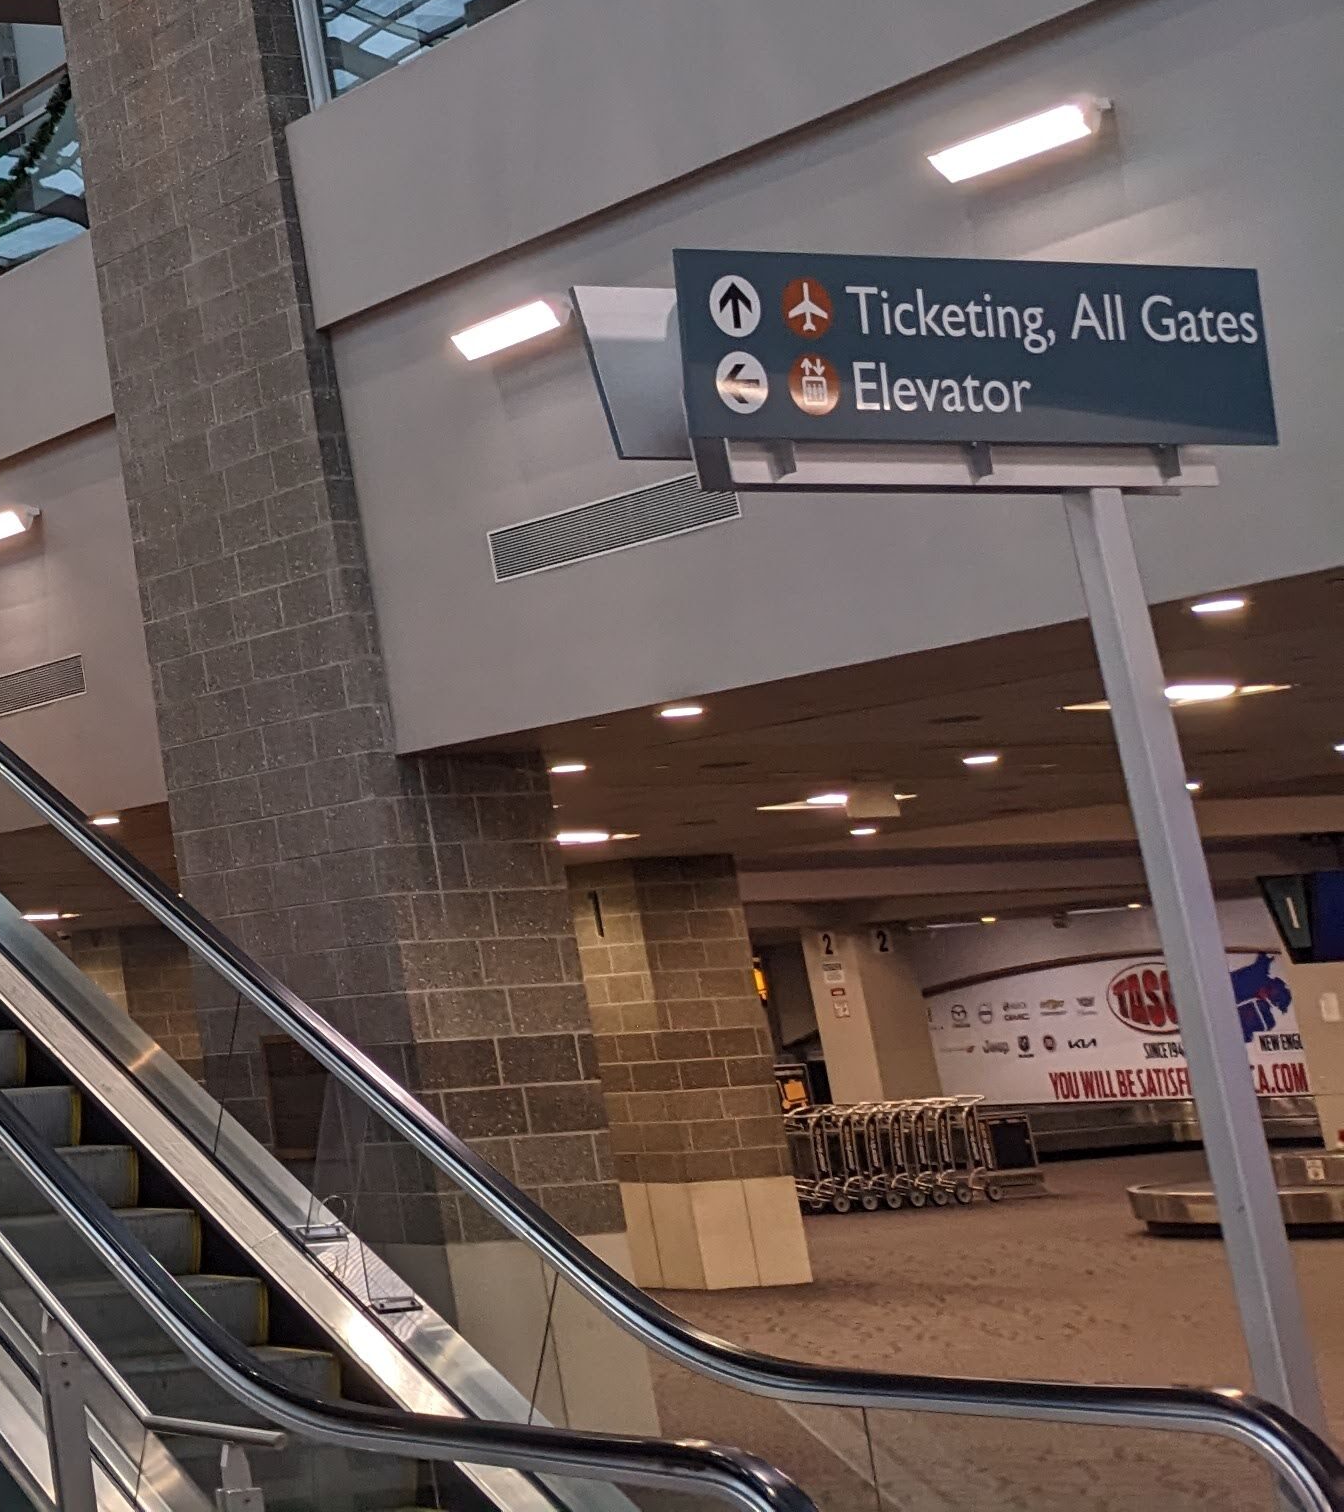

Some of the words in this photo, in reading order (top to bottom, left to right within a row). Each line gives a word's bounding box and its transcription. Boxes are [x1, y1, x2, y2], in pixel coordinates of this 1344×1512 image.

[845, 285, 1057, 354] Ticketing,
[1071, 292, 1127, 341] All
[1141, 294, 1259, 344] Gates
[852, 361, 1032, 414] Elevator
[822, 933, 834, 955] 2
[876, 929, 889, 953] 2
[1048, 1071, 1080, 1100] YOU
[1079, 1070, 1118, 1099] WILL
[1115, 1069, 1138, 1098] BE
